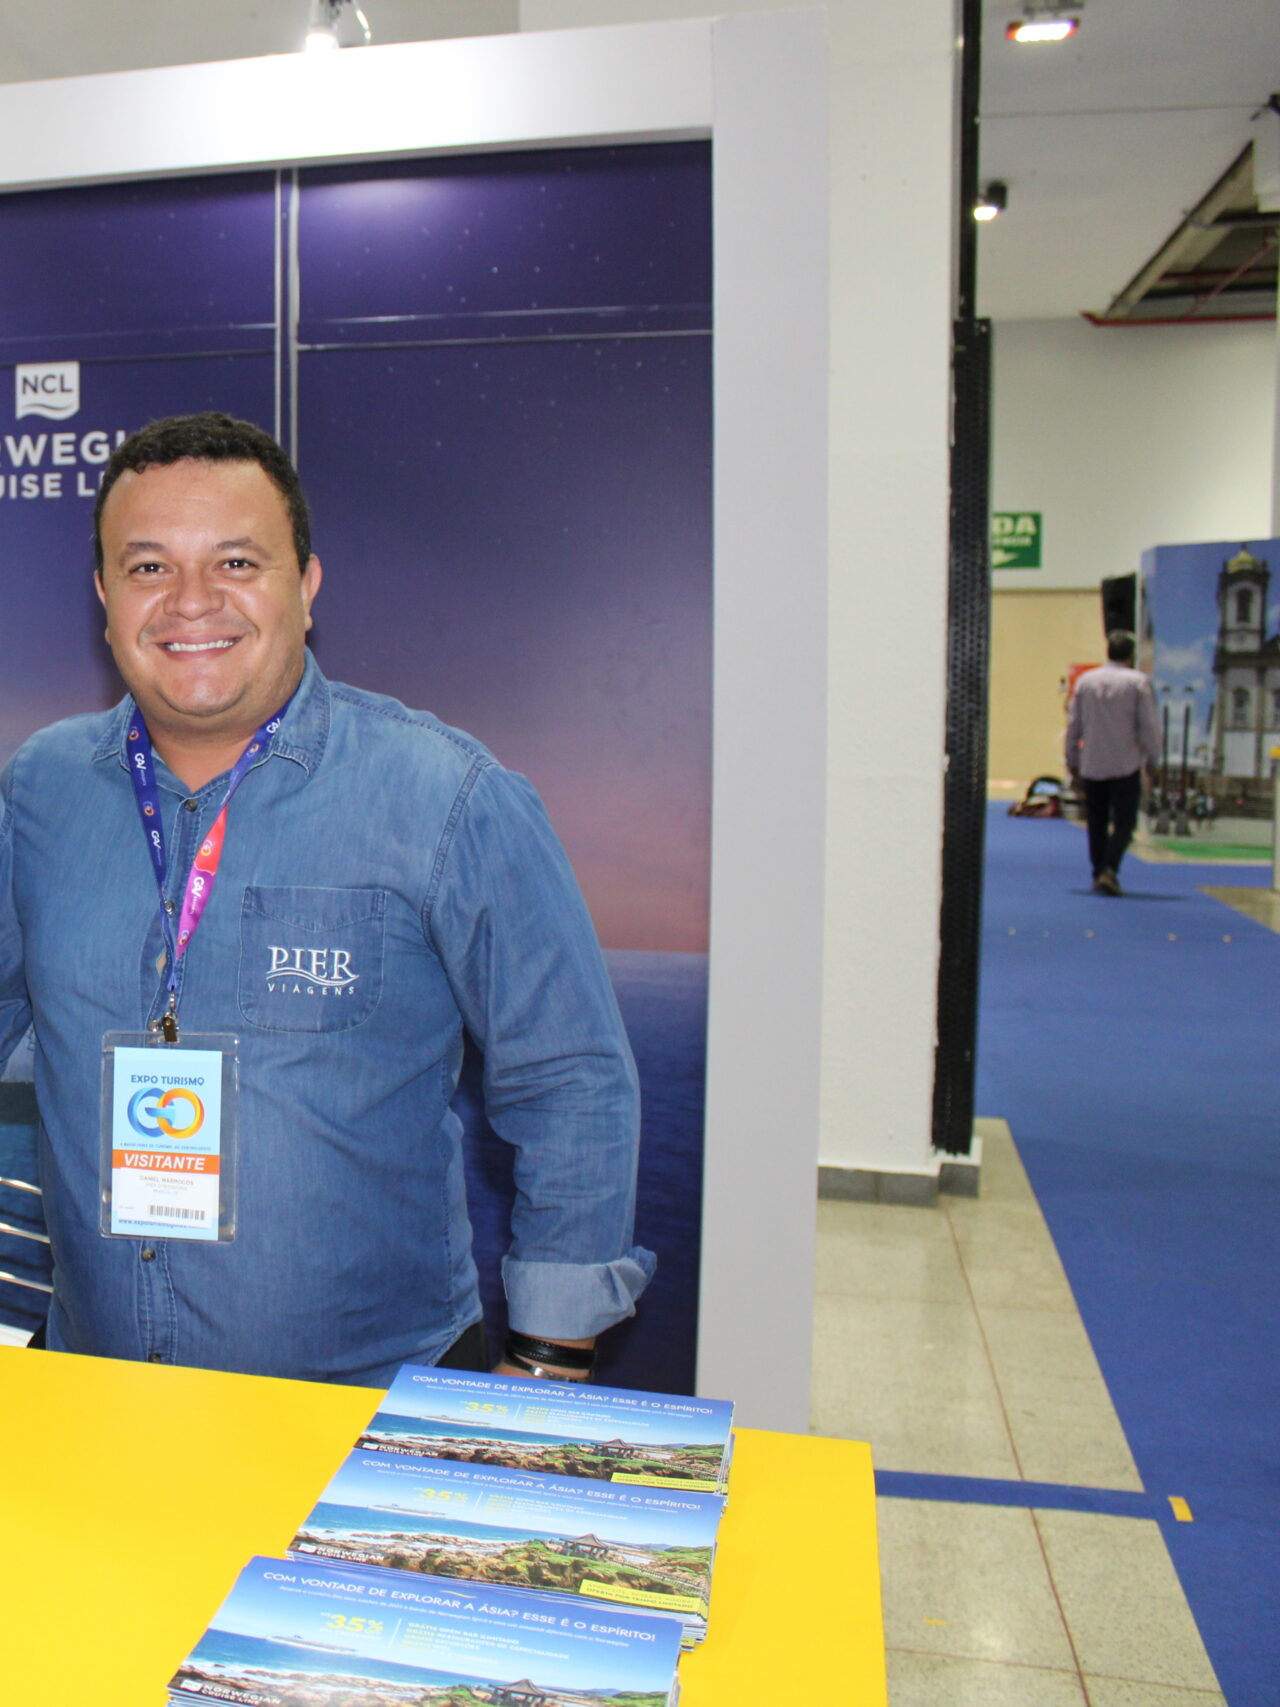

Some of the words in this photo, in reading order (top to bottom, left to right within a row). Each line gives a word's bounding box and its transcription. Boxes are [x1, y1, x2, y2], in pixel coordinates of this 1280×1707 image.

[22, 375, 73, 394] NCL
[267, 946, 354, 980] PIER
[268, 983, 355, 996] VIAGENS
[131, 1075, 158, 1084] EXPO
[161, 1076, 204, 1086] TURISMO
[124, 1153, 205, 1171] VISITANTE
[412, 1375, 438, 1383] COM
[441, 1378, 491, 1389] VONTADE
[512, 1385, 564, 1397] EXPLORAR
[579, 1390, 609, 1402] ÁSIA?
[612, 1397, 637, 1406] ESSE
[641, 1398, 649, 1407] É
[664, 1402, 713, 1415] ESPÍRITO!
[362, 1459, 391, 1468] COM
[395, 1463, 450, 1476] VONTADE
[454, 1471, 470, 1479] DE
[473, 1473, 534, 1488] EXPLORAR
[549, 1480, 584, 1495] ÁSIA?
[587, 1490, 616, 1498] ESSE
[619, 1492, 628, 1501] É
[645, 1496, 702, 1510] ESPÍRITO!
[263, 1571, 296, 1583] COM
[300, 1577, 365, 1594] VONTADE
[368, 1586, 387, 1597] DE
[391, 1590, 460, 1609] EXPLORAR
[464, 1602, 476, 1611] A
[478, 1602, 518, 1617] ÁSIA?
[522, 1612, 556, 1624] ESSE
[560, 1617, 570, 1627] É
[574, 1621, 587, 1630] O
[591, 1622, 657, 1642] ESPÍRITO!
